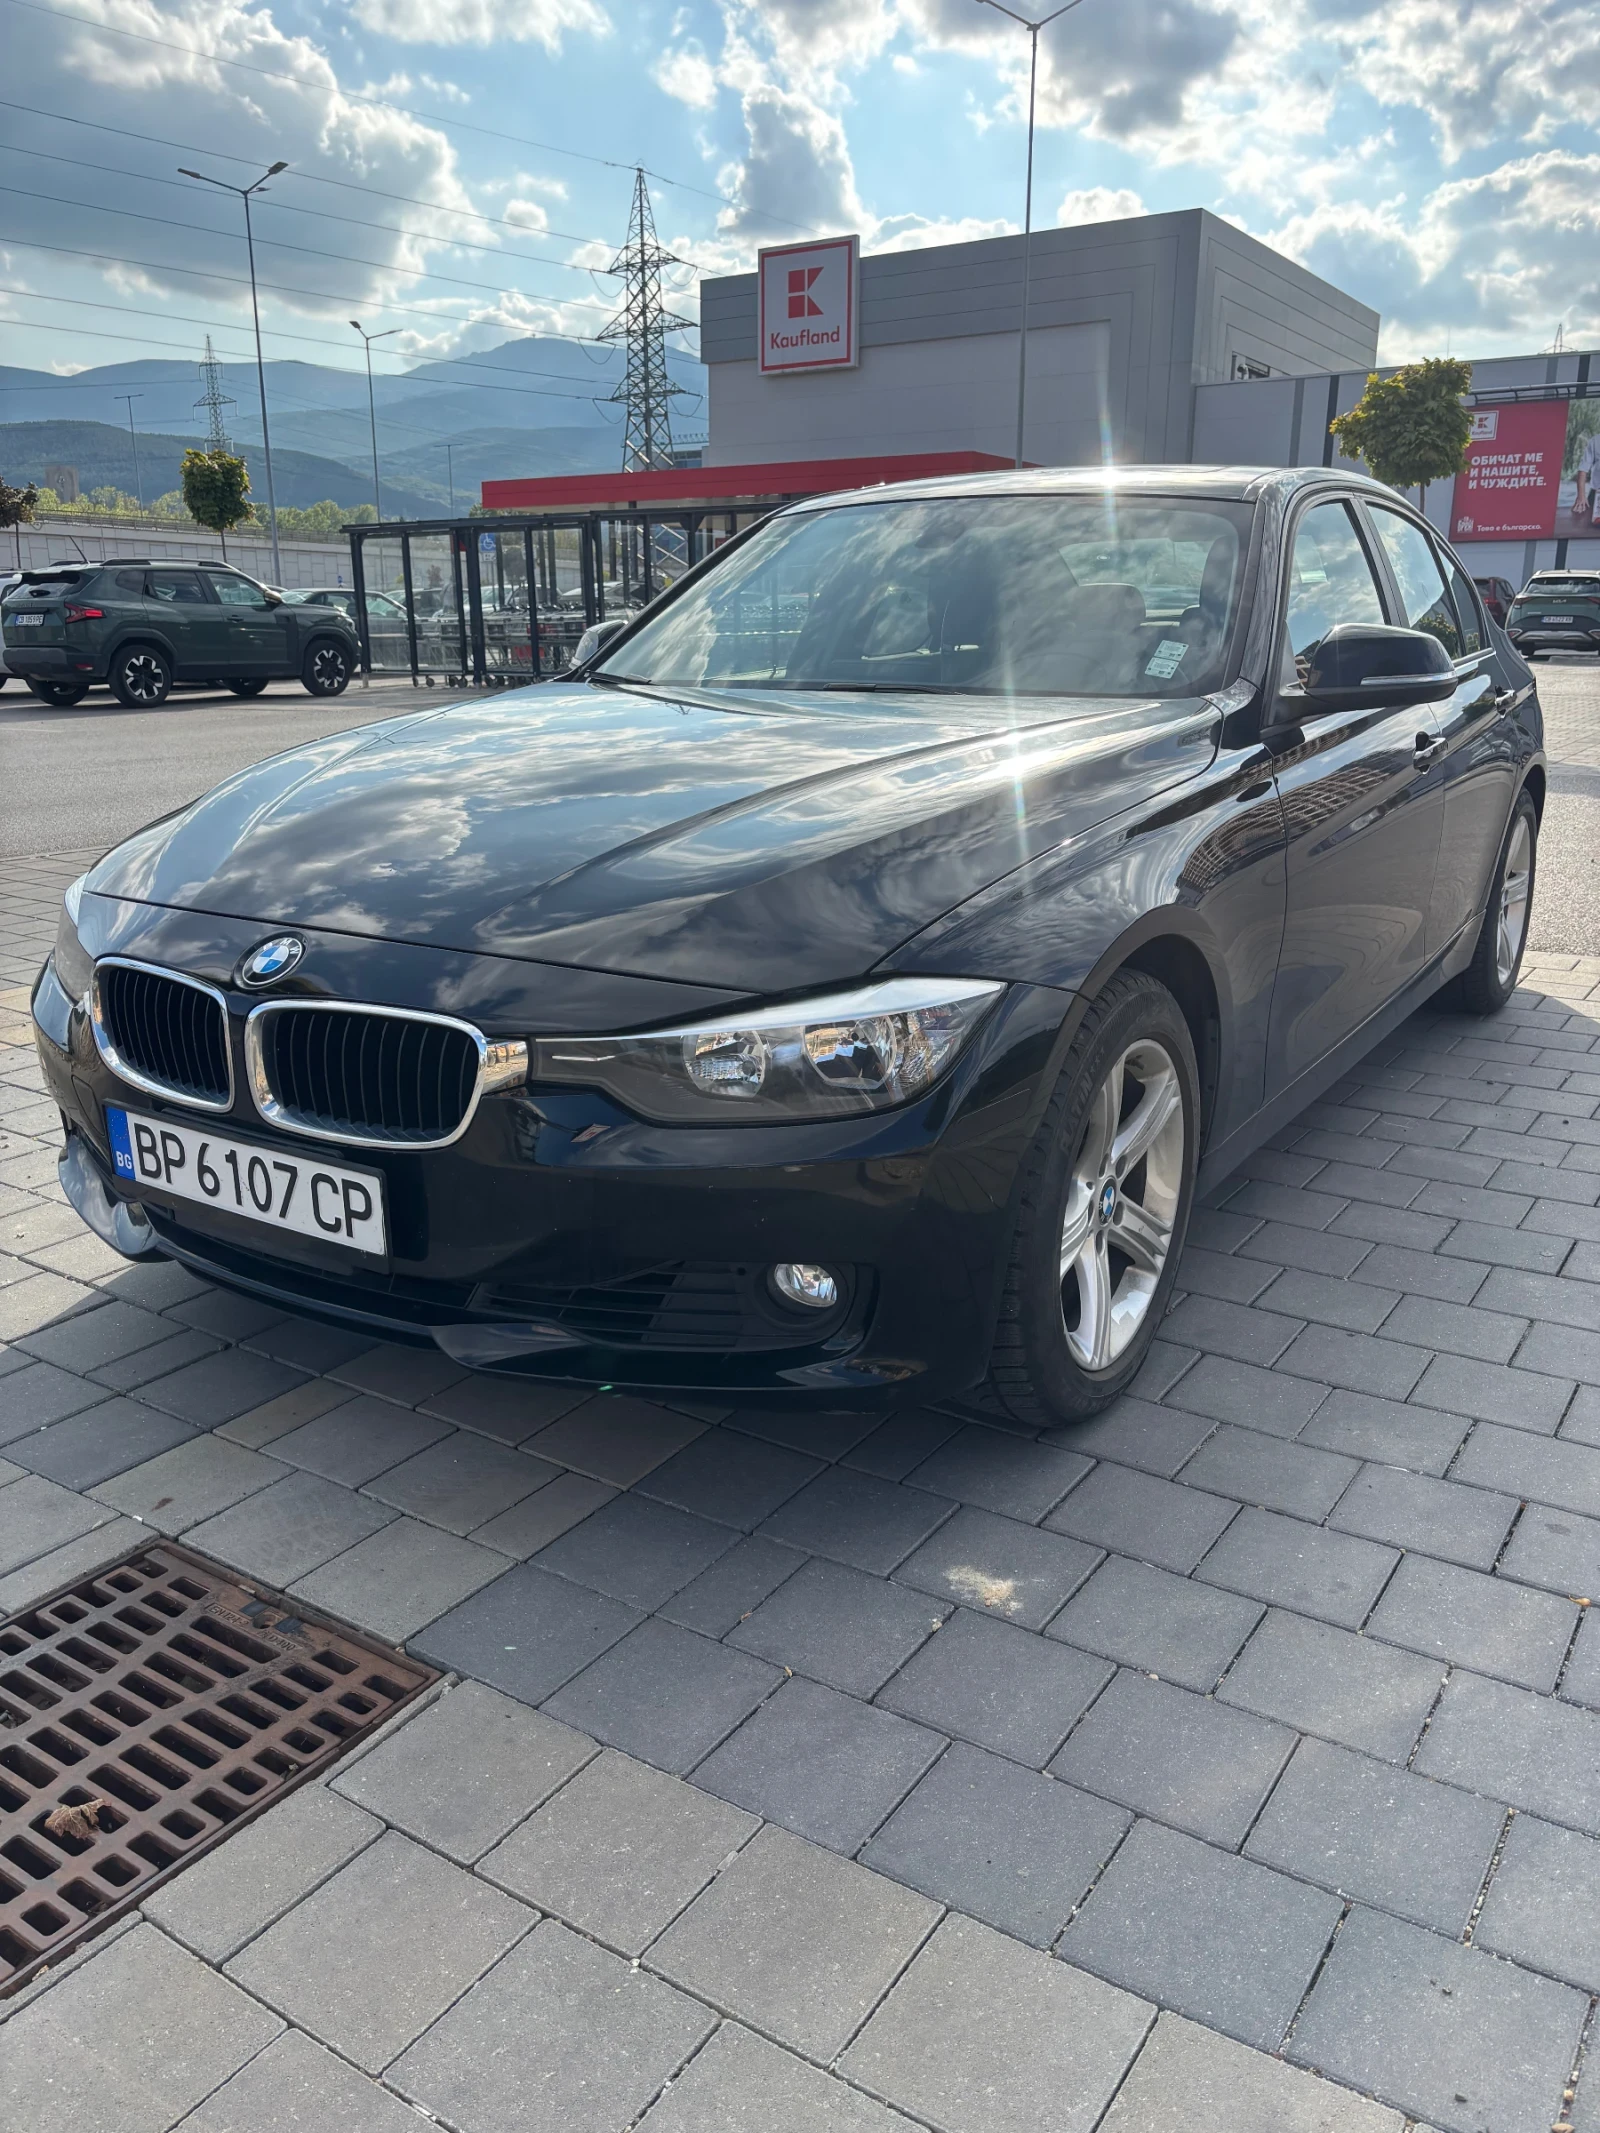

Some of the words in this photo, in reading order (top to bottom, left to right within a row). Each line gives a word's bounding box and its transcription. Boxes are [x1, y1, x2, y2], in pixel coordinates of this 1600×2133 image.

[770, 325, 840, 349] Kaufland
[1471, 453, 1521, 466] ОБИЧАТ
[1524, 452, 1543, 463] МЕ
[1469, 468, 1479, 478] И
[1481, 465, 1539, 477] НАШИТЕ,
[1468, 479, 1477, 489] И
[1480, 476, 1547, 489] ЧУЖДИТЕ.
[115, 1150, 133, 1170] BG
[134, 1122, 186, 1184] BP
[197, 1142, 298, 1219] 6107
[310, 1172, 373, 1238] CP
